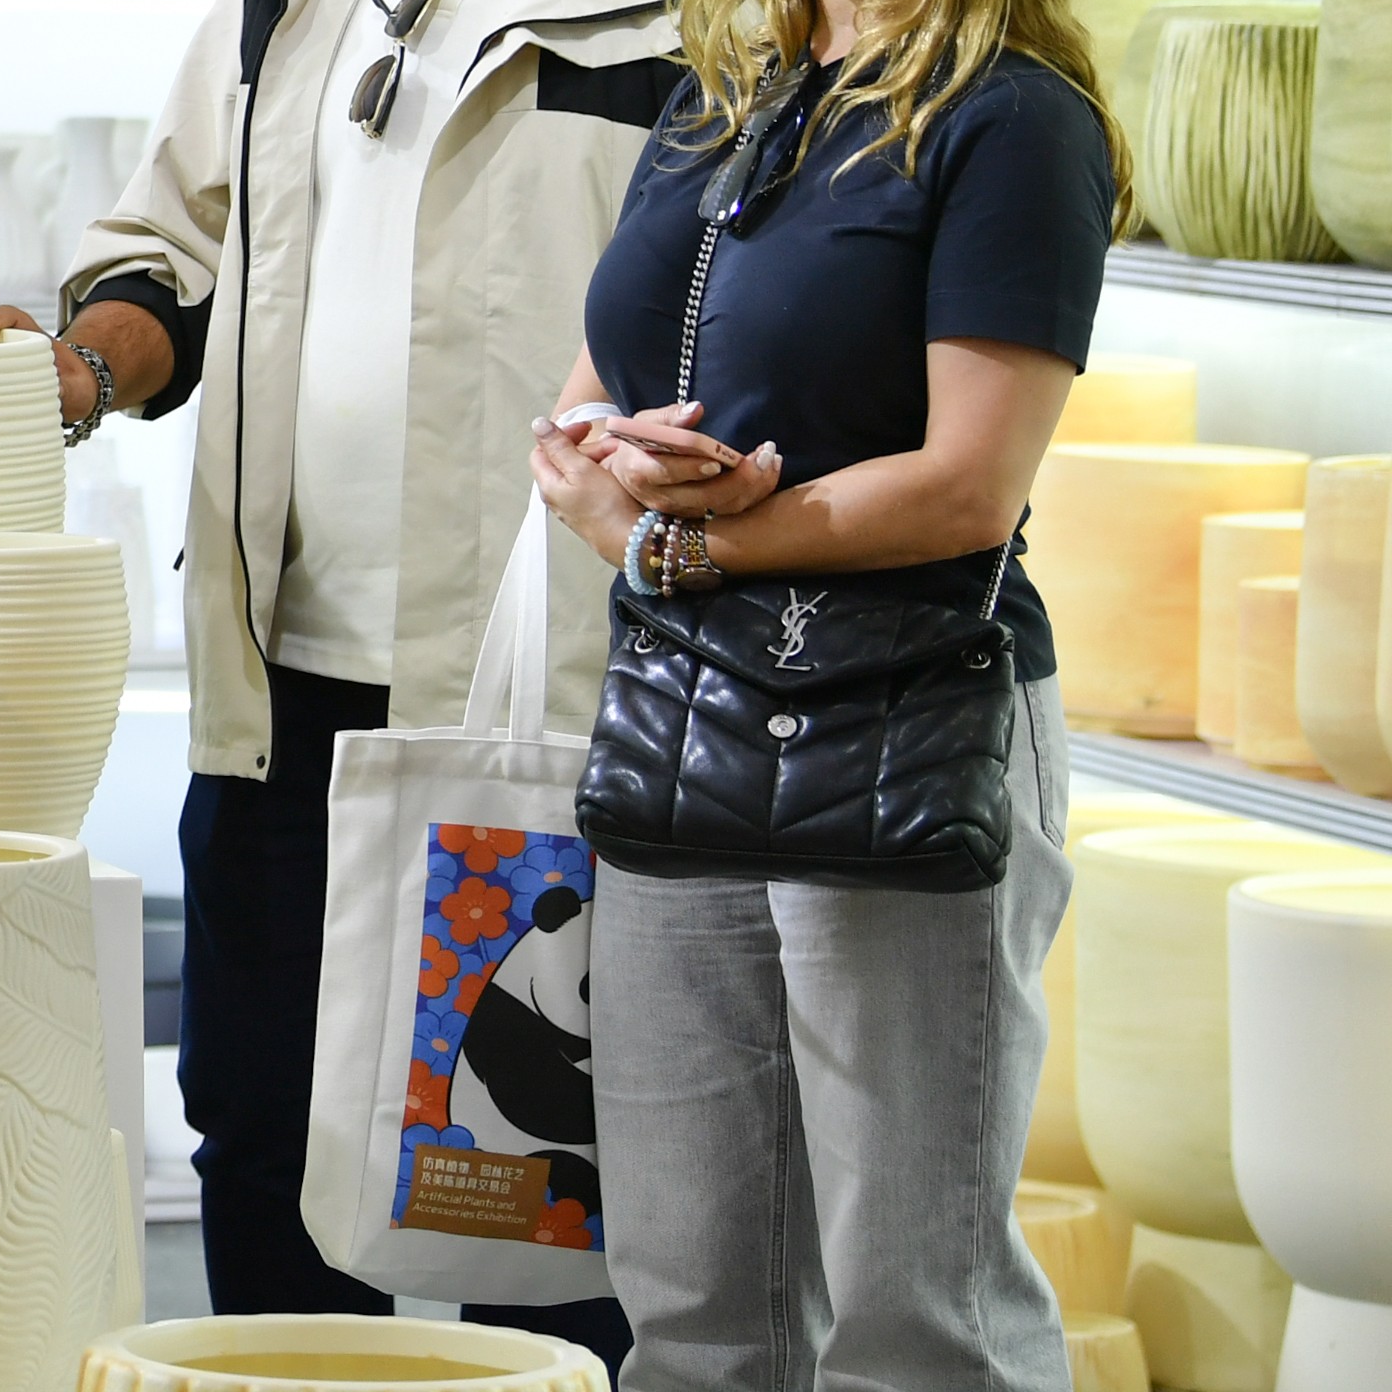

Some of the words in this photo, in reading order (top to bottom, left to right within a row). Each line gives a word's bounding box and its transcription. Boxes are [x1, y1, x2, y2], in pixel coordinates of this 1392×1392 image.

[416, 1190, 463, 1205] Artificial
[463, 1195, 496, 1209] Plants
[496, 1201, 517, 1211] and
[412, 1202, 475, 1219] Accessories
[476, 1210, 528, 1225] Exhibition
